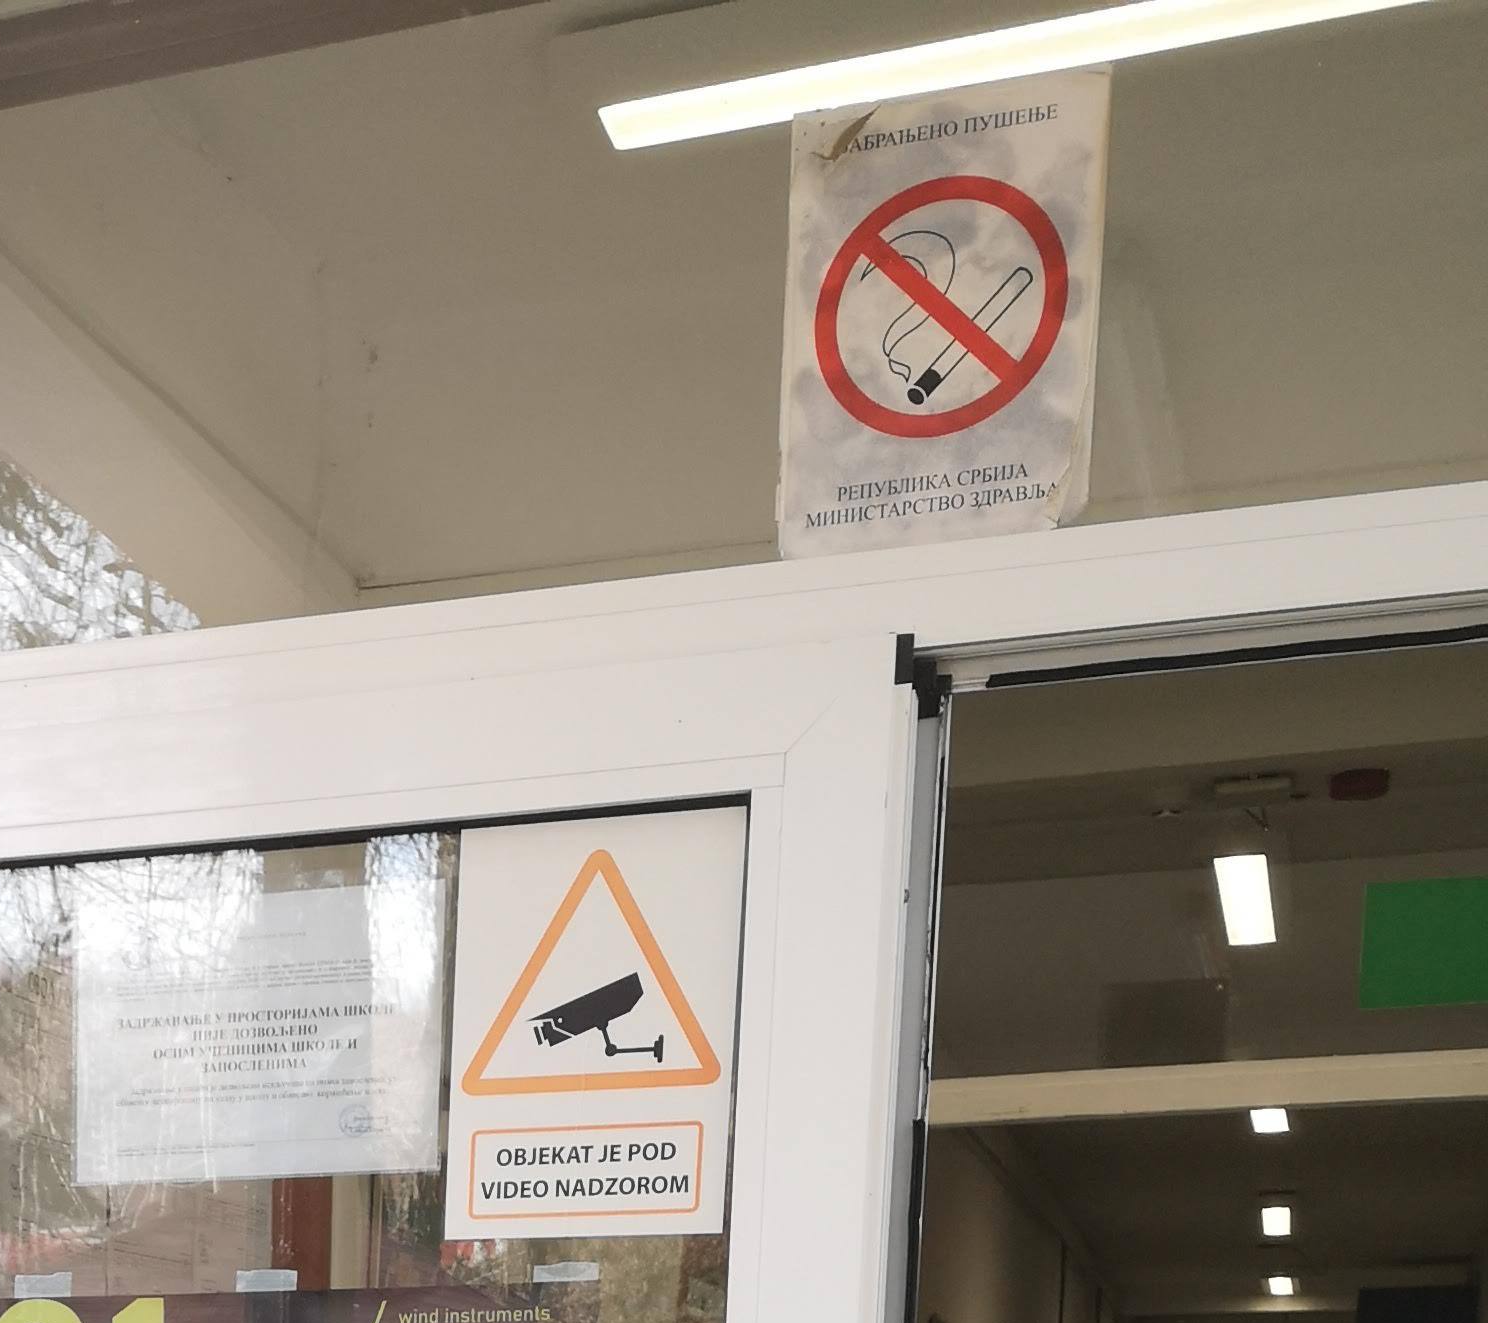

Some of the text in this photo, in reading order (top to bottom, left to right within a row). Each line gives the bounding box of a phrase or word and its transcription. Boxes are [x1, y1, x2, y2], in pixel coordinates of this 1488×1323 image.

[964, 103, 1059, 134] ПУШЕЊЕ
[837, 463, 1028, 502] РЕПУБЛИКА СРБИЈА
[805, 482, 1058, 529] МИНИСТАРСТВО ЗДРАВЉА
[227, 1006, 339, 1023] ПРОСТОРИЈАМА
[233, 1024, 318, 1040] ДОЗВОЉЕНО
[348, 1038, 357, 1050] И
[496, 1142, 676, 1167] OBJEKAT JE POD
[481, 1175, 689, 1200] VIDEO NADZOROM
[445, 1306, 551, 1323] instruments
